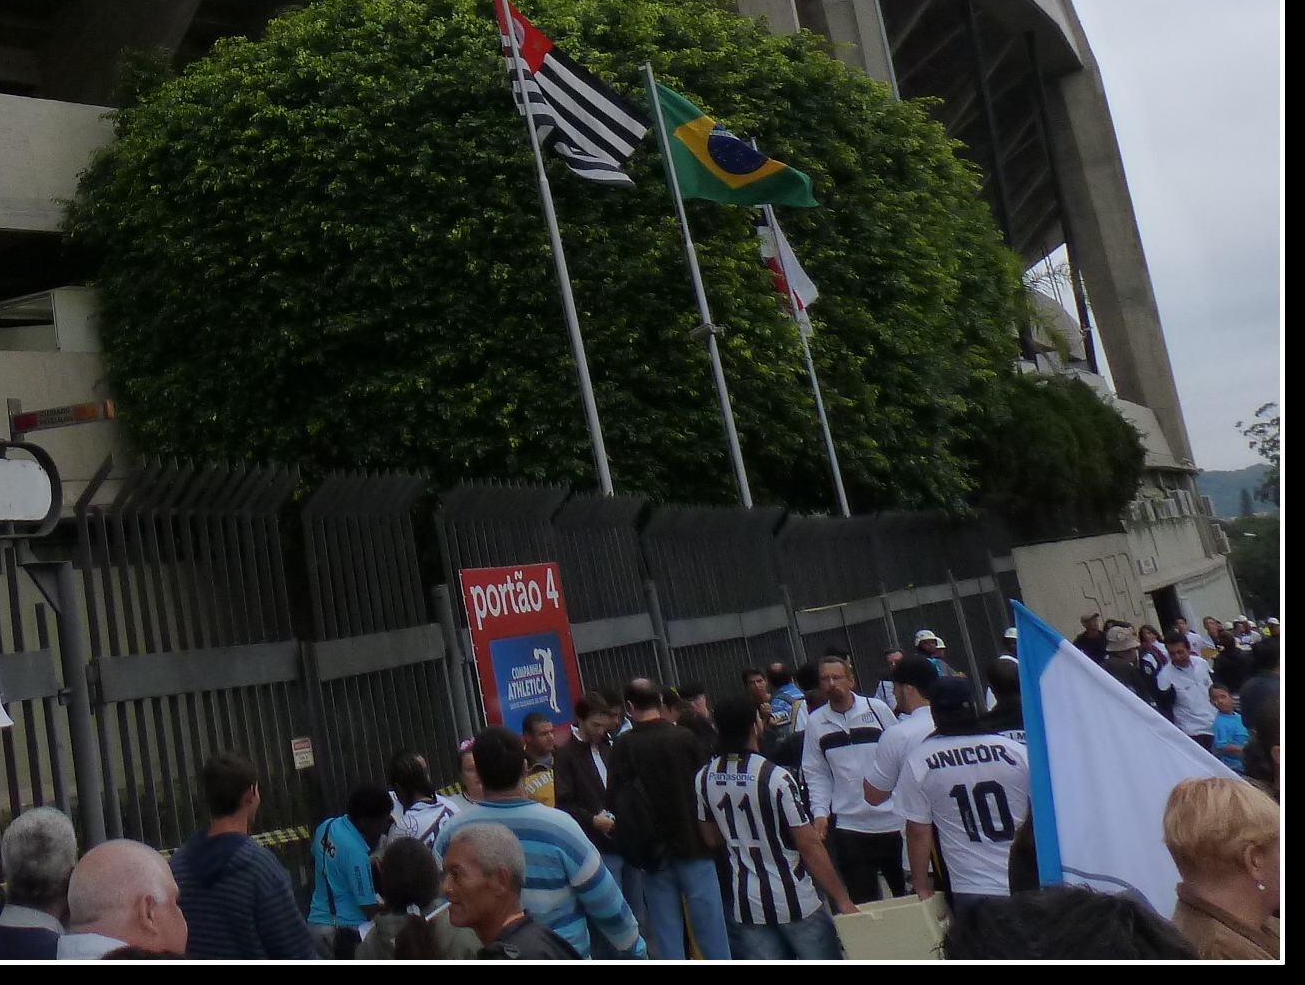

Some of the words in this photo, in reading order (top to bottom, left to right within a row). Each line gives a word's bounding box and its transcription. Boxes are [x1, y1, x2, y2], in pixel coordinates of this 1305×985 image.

[470, 570, 542, 631] portão
[546, 567, 559, 608] 4
[508, 677, 547, 700] ATHLETICA
[512, 663, 542, 679] COMPANHIA
[708, 772, 756, 782] Panasonic
[716, 792, 761, 840] 11
[949, 780, 1015, 843] 10
